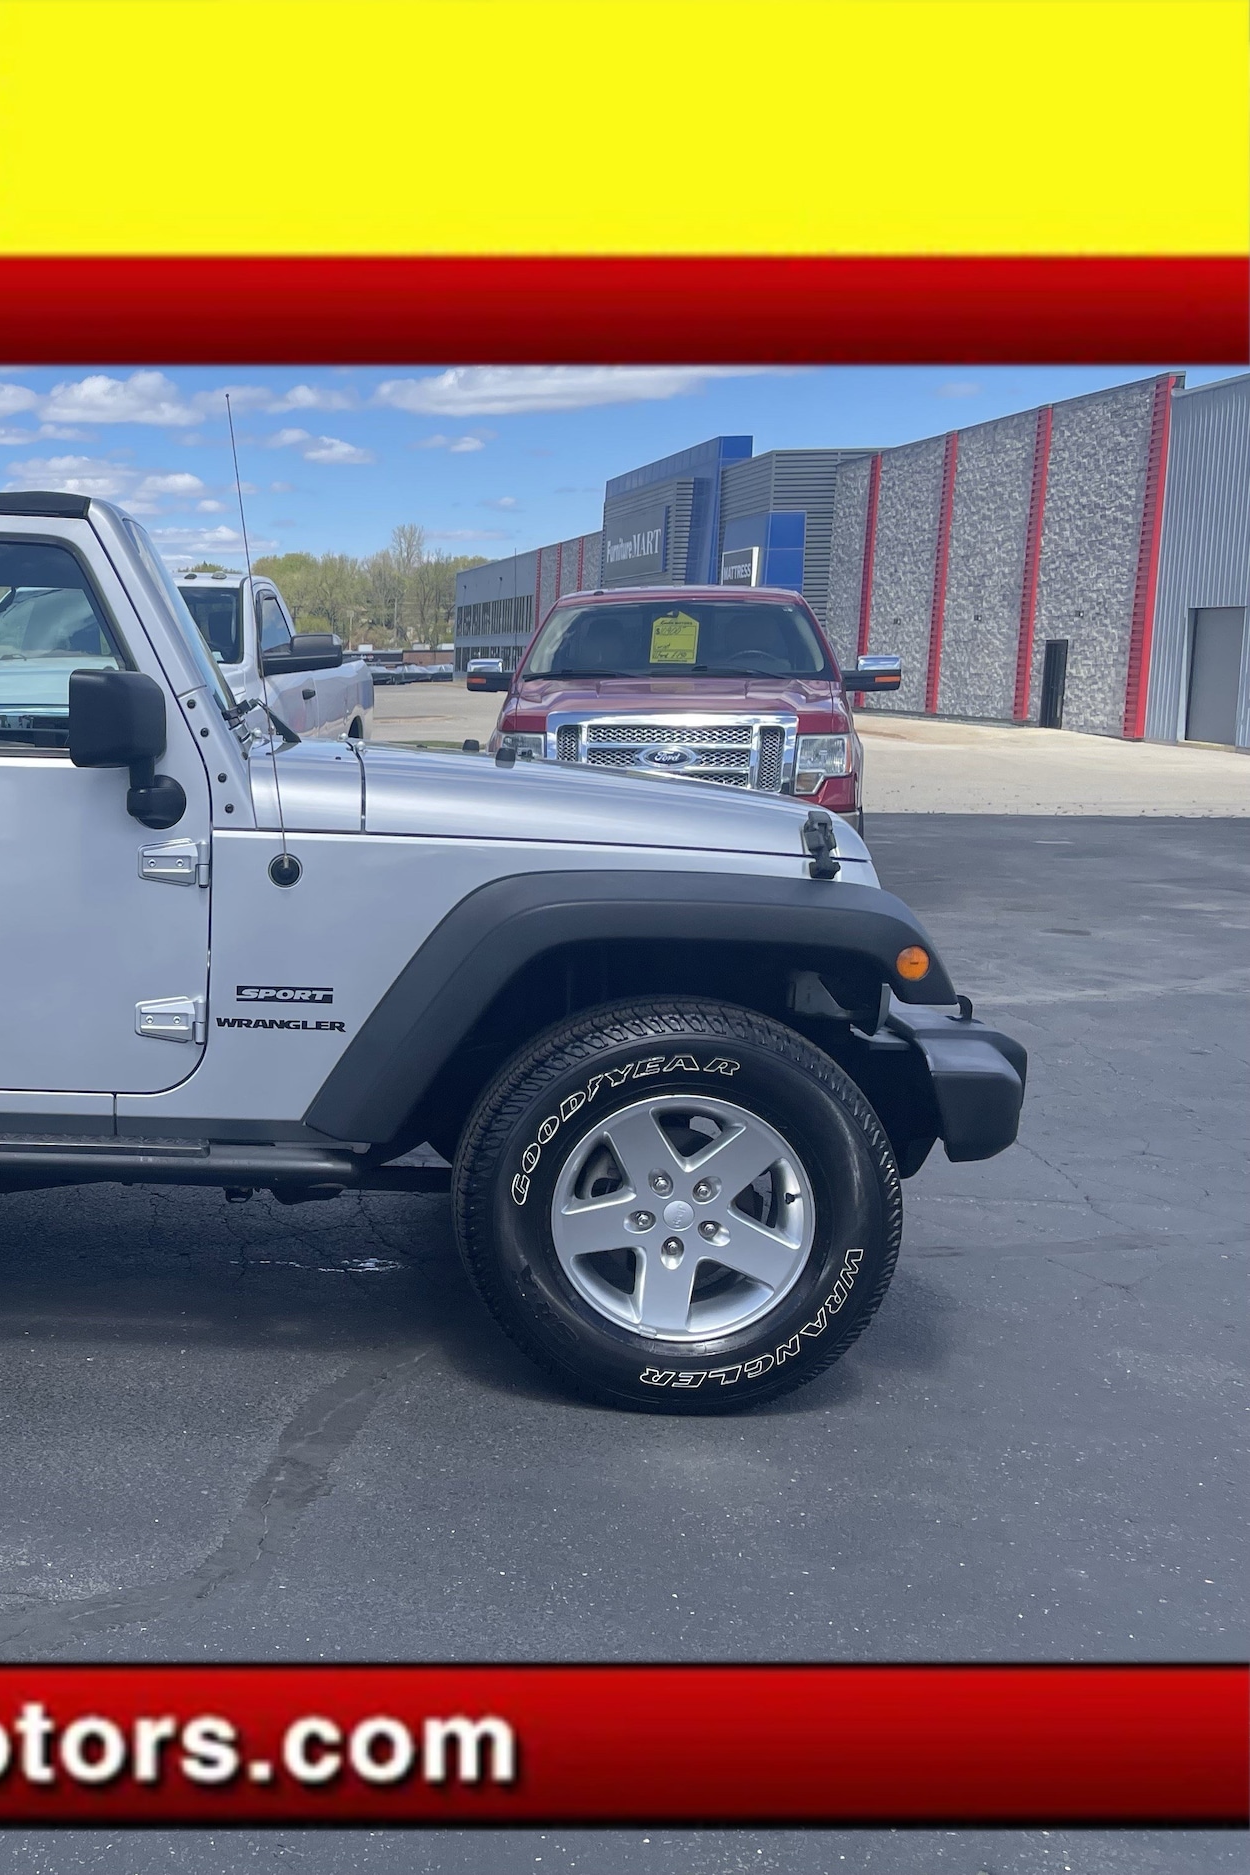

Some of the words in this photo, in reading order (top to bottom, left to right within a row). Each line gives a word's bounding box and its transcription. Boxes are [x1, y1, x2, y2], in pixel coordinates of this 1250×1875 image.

[723, 563, 751, 581] MATTRESS
[654, 750, 681, 762] Ford
[239, 988, 333, 1001] SPORT
[216, 1017, 347, 1033] WRANGLER
[510, 1055, 741, 1206] GOODYEAR
[639, 1247, 865, 1389] WRANGLER
